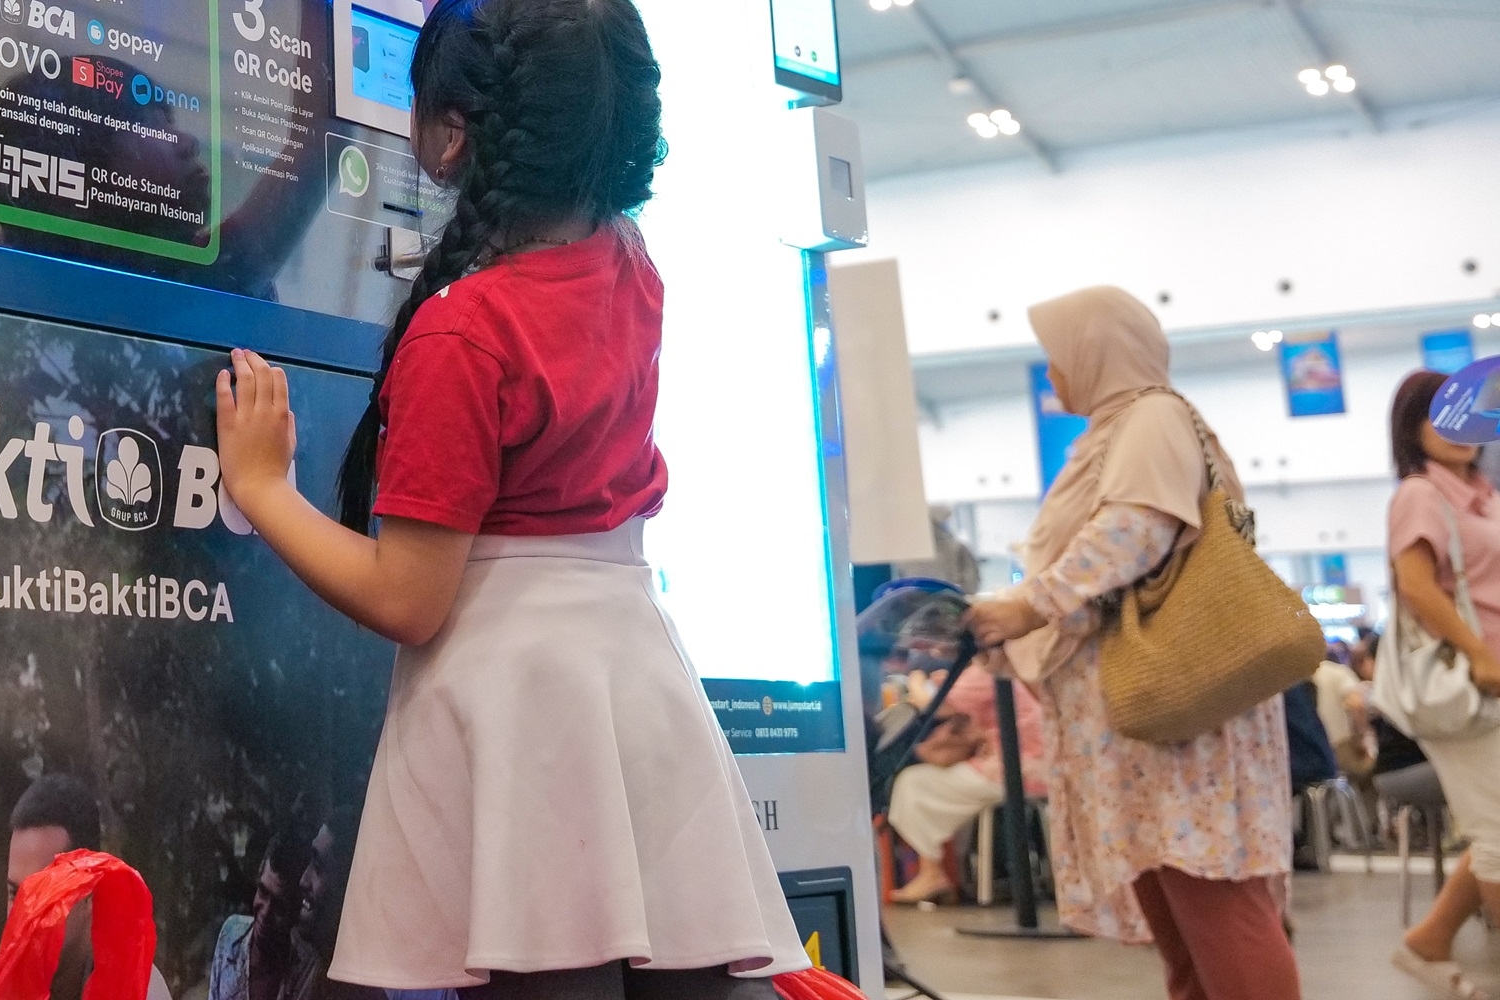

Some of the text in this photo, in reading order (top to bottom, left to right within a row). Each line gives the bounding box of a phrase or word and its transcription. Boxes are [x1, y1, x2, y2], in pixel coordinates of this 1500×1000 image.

[27, 0, 164, 62] BCA gopay
[269, 25, 312, 60] Scan
[234, 49, 313, 94] QR Code
[96, 60, 124, 78] Shopee
[155, 86, 200, 112] DANA
[96, 72, 124, 100] Pay
[241, 91, 314, 118] Klik Ambil Poin pada Layar
[17, 93, 41, 112] yang
[42, 97, 67, 115] telah
[69, 105, 102, 124] ditukar
[104, 115, 130, 132] dapat
[132, 122, 178, 144] digunakan
[39, 115, 75, 136] dengan
[241, 107, 308, 134] Buka Aplikasi Plasticpay
[241, 125, 304, 149] Scan QR Code dengan
[242, 142, 294, 164] Aplikasi Plasticpay
[91, 166, 181, 200] QR Code Standar
[242, 160, 299, 181] Klik Konfirmasi Poin
[91, 187, 204, 226] Pembayaran Nasional
[111, 507, 148, 523] GRUP BCA
[773, 700, 821, 712] www.jumpstart.id
[731, 728, 752, 738] Service
